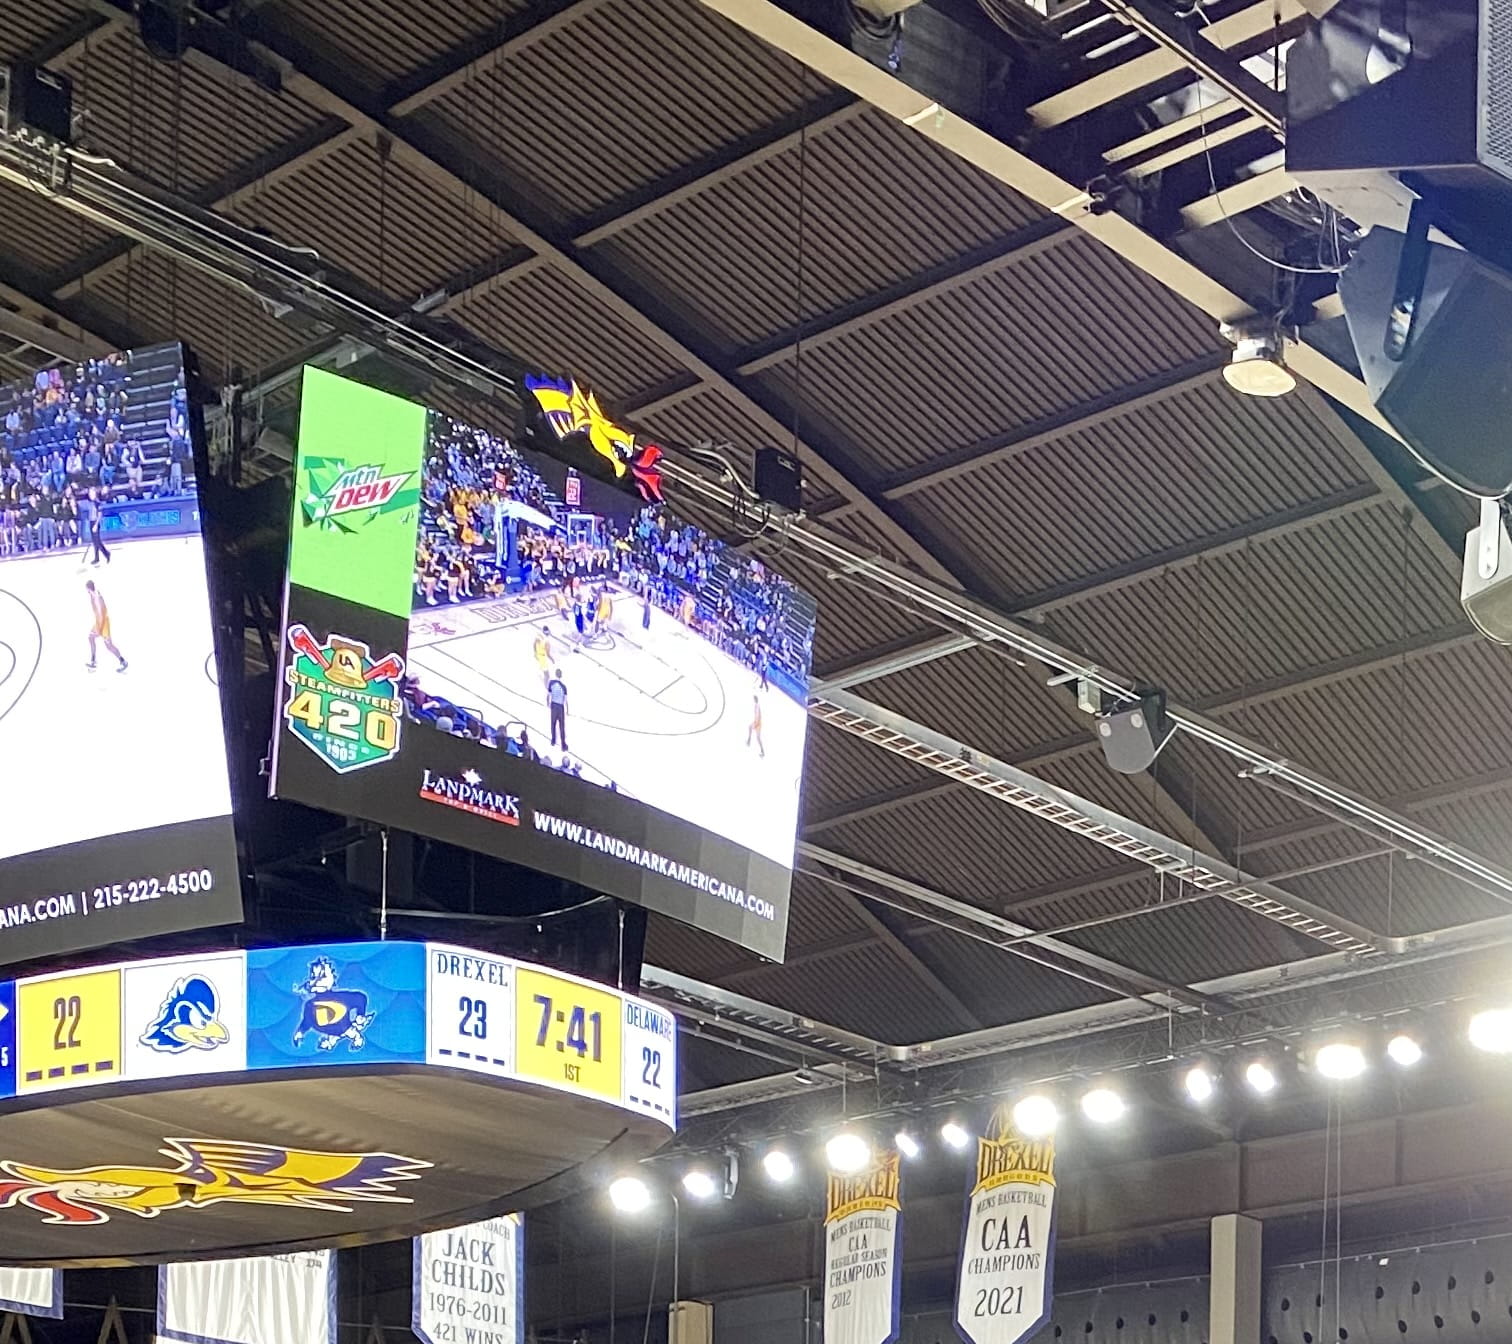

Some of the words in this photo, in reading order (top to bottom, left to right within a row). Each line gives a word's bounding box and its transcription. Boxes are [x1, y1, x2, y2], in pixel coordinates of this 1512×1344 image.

[289, 669, 400, 713] STEAMFITTERS
[288, 690, 397, 751] 420
[422, 769, 520, 820] LANDMARK
[533, 811, 775, 921] WWW.LANDMARKAMERICANA.COM
[94, 869, 213, 909] 215-222-4500
[437, 953, 508, 987] DREXEL
[53, 995, 82, 1050] 22
[458, 996, 487, 1040] 23
[533, 994, 602, 1063] 7:41
[564, 1063, 582, 1083] 1ST
[642, 1046, 662, 1089] 22
[979, 1141, 1051, 1184] DREXEL
[976, 1194, 997, 1216] MENS
[442, 1233, 496, 1267] JACK
[981, 1214, 1033, 1252] CAA
[431, 1258, 506, 1297] CHILDS
[829, 1261, 887, 1289] CHAMPIONS
[968, 1253, 1041, 1275] CHAMPIONS
[429, 1292, 508, 1326] 1976-2011
[974, 1286, 1024, 1317] 2021
[433, 1321, 457, 1343] 421
